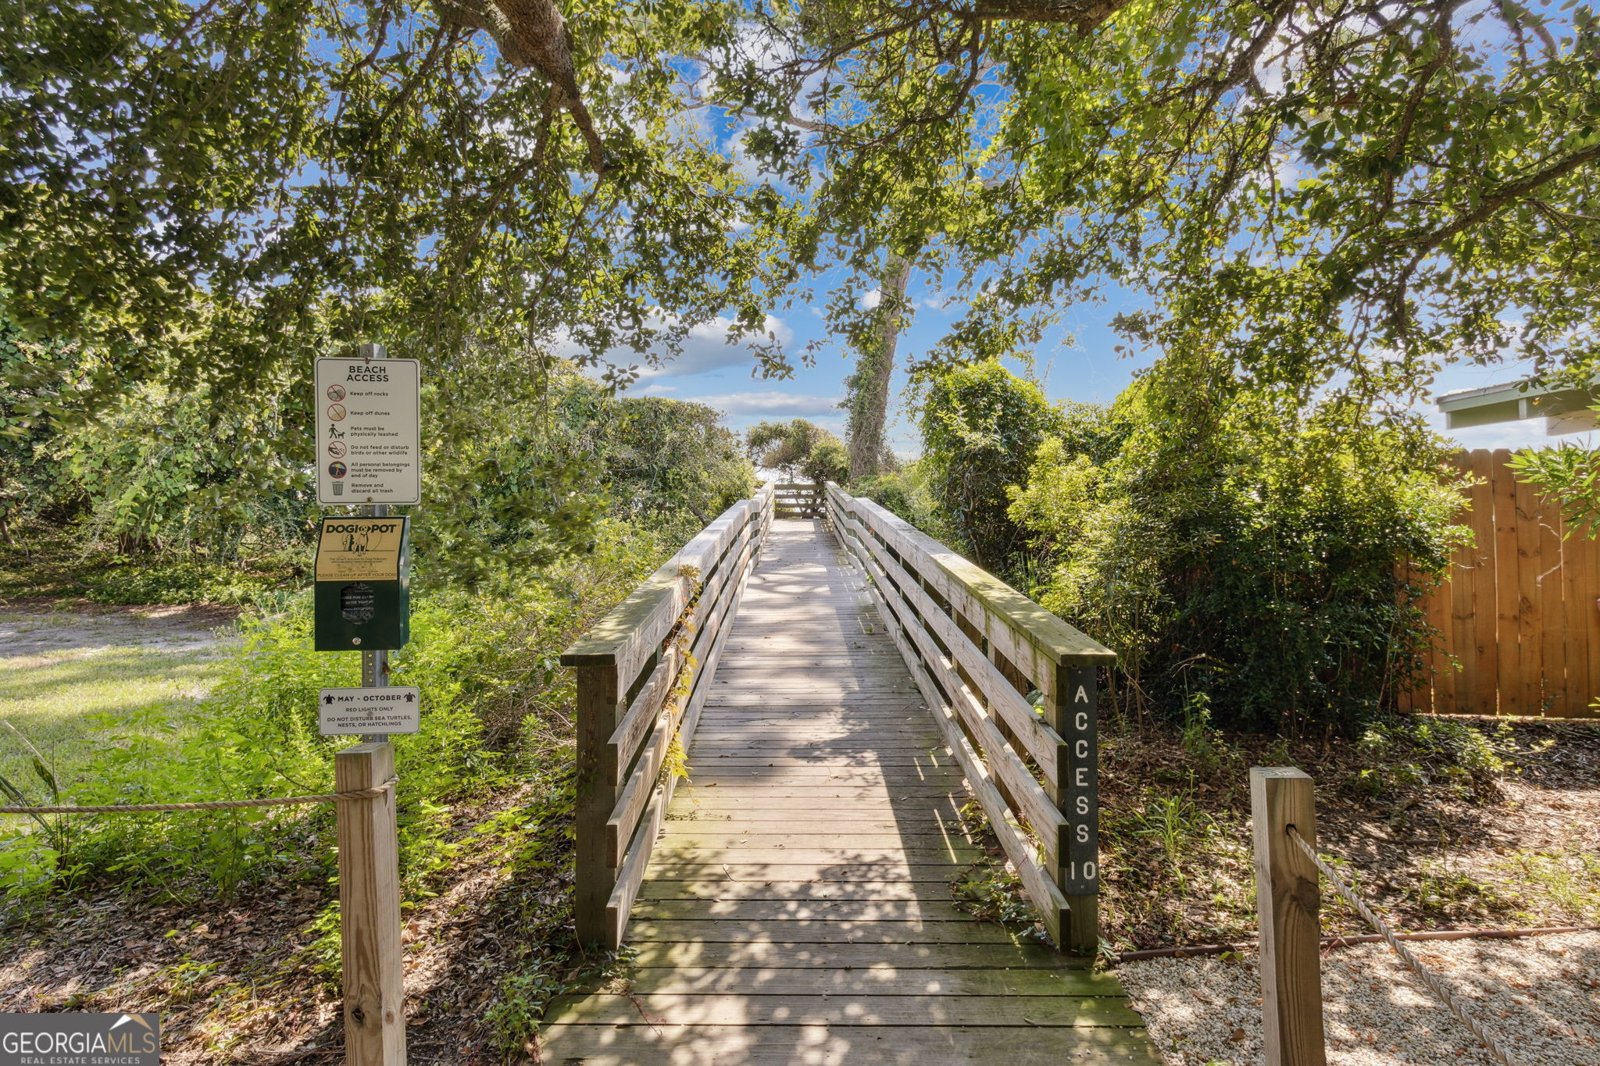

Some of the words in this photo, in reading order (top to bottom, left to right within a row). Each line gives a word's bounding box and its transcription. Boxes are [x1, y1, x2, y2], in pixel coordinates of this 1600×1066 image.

[349, 366, 386, 374] BEACH
[346, 374, 389, 382] ACCESS
[1074, 685, 1089, 843] ACCESS
[1070, 861, 1096, 880] 10
